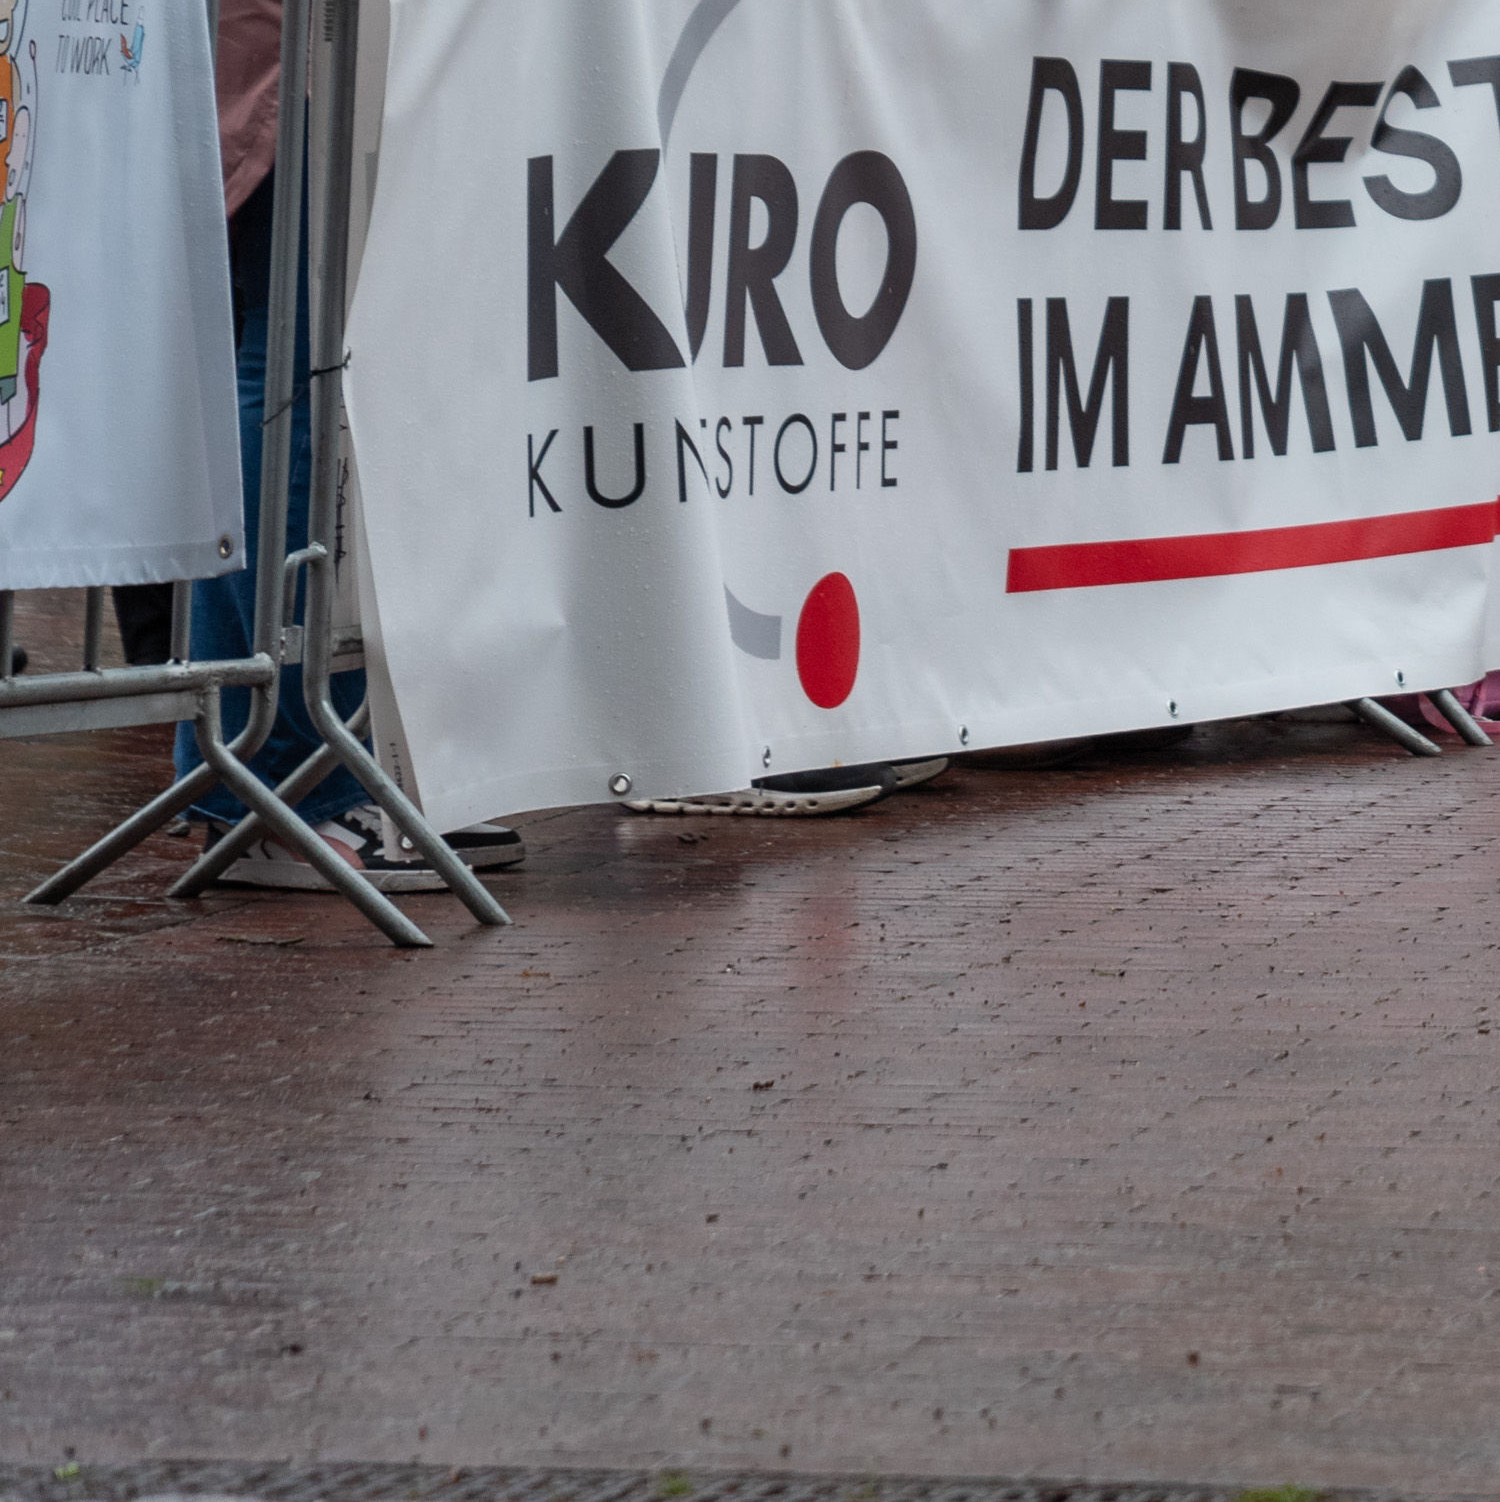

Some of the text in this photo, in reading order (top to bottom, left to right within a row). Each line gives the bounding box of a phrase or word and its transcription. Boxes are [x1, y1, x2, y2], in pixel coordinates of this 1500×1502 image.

[56, 34, 112, 76] TO WORK
[1017, 55, 1213, 231] DER
[527, 148, 918, 382] KIRO
[1017, 296, 1130, 474] IM
